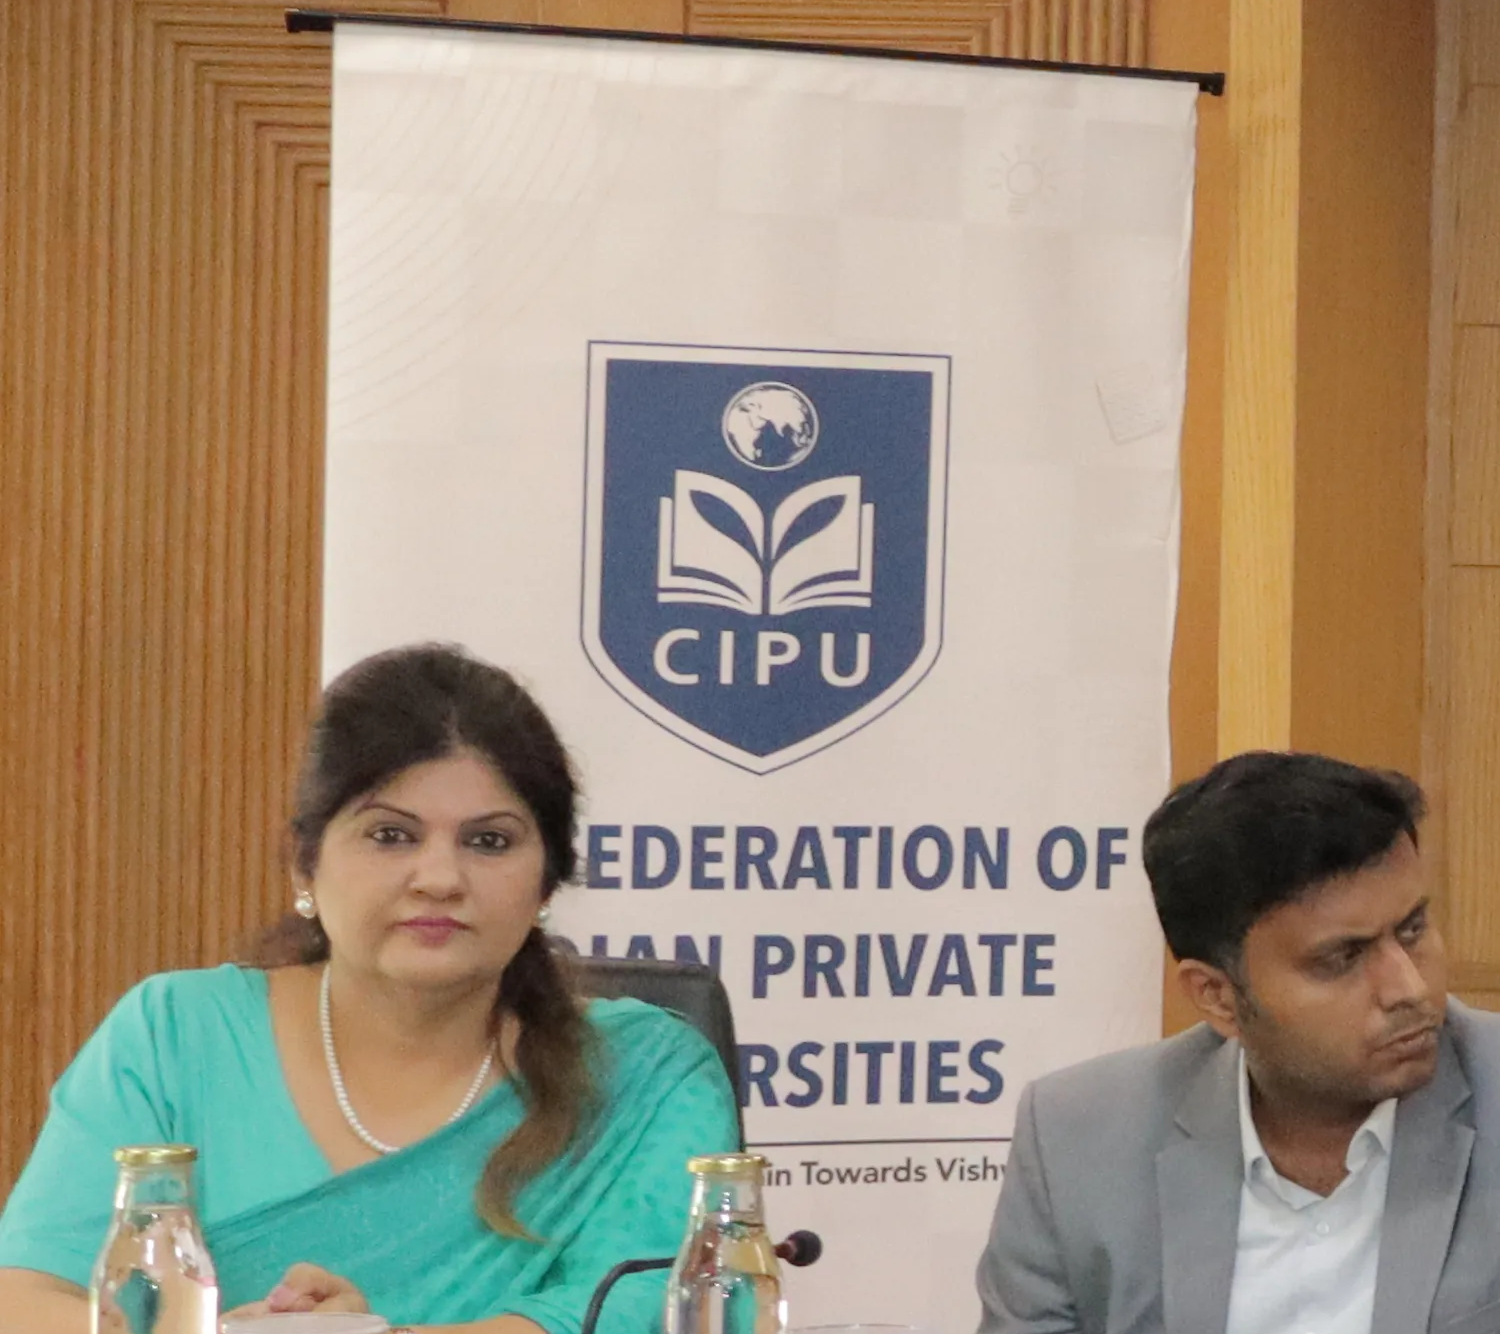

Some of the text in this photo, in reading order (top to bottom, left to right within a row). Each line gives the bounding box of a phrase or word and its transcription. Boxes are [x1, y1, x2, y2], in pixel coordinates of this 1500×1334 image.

[653, 627, 871, 688] CIPU
[585, 824, 1129, 892] EDERATION OF
[752, 933, 1057, 999] PRIVATE
[737, 1038, 1006, 1108] RSITIES
[765, 1162, 792, 1187] in
[801, 1157, 928, 1187] Towards
